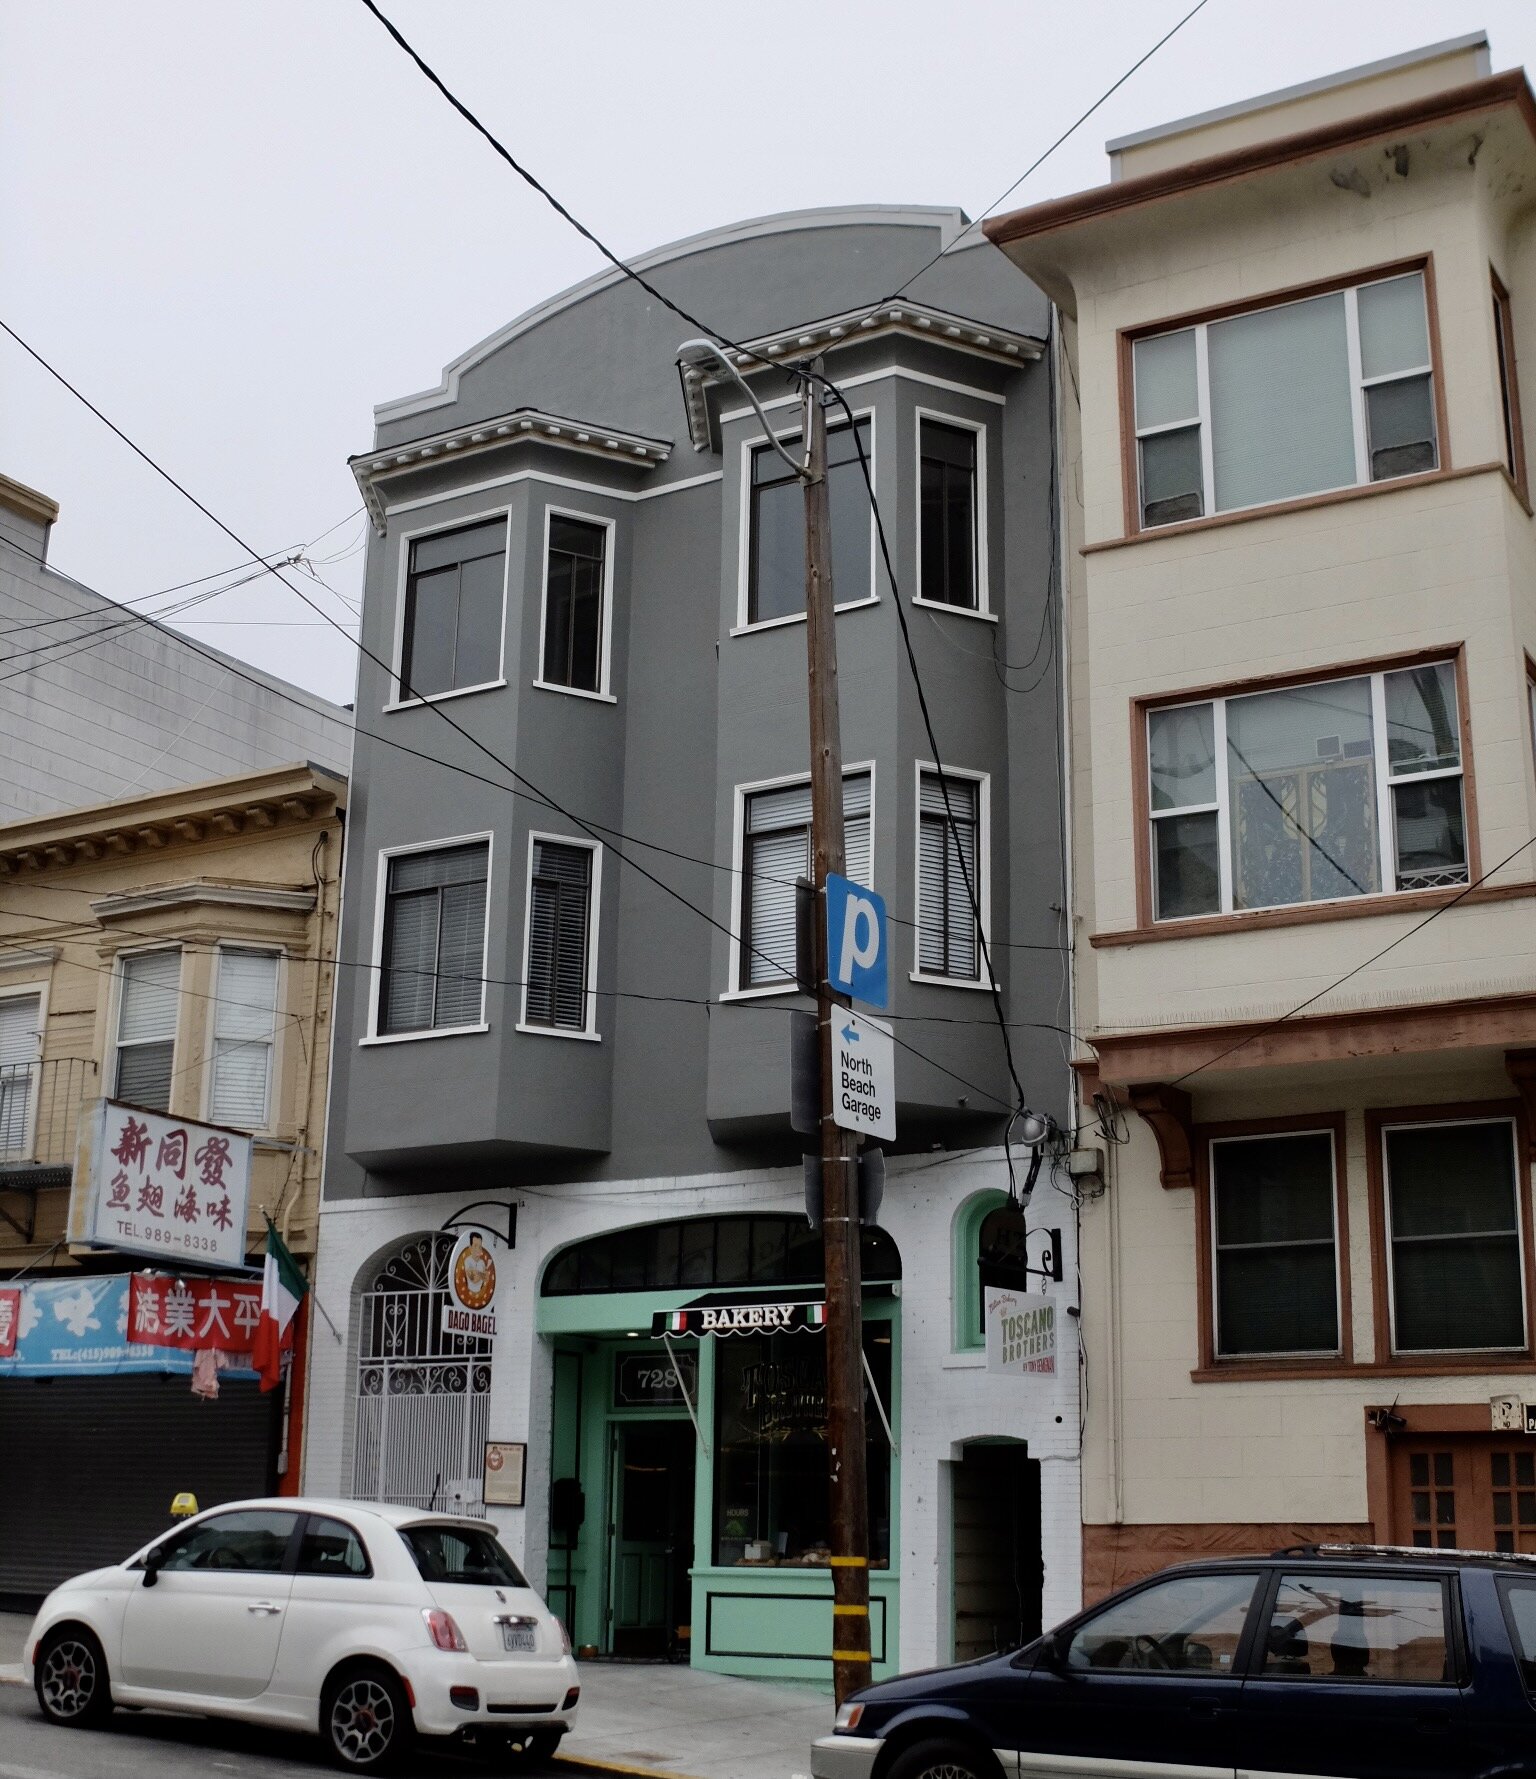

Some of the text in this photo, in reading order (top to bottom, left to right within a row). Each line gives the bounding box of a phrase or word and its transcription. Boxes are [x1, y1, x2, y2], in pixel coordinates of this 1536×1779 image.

[840, 1050, 873, 1077] North
[841, 1072, 876, 1098] Beach
[841, 1092, 882, 1122] Garage
[111, 1115, 233, 1190] 新同發
[106, 1168, 233, 1232] 魚翅海味
[447, 1309, 497, 1335] DAGO BAGEL
[701, 1305, 795, 1330] BAKERY
[1001, 1305, 1054, 1345] TOSCANO
[1002, 1332, 1055, 1364] BROTHERS
[637, 1368, 678, 1390] 728
[726, 1508, 749, 1517] HOURS
